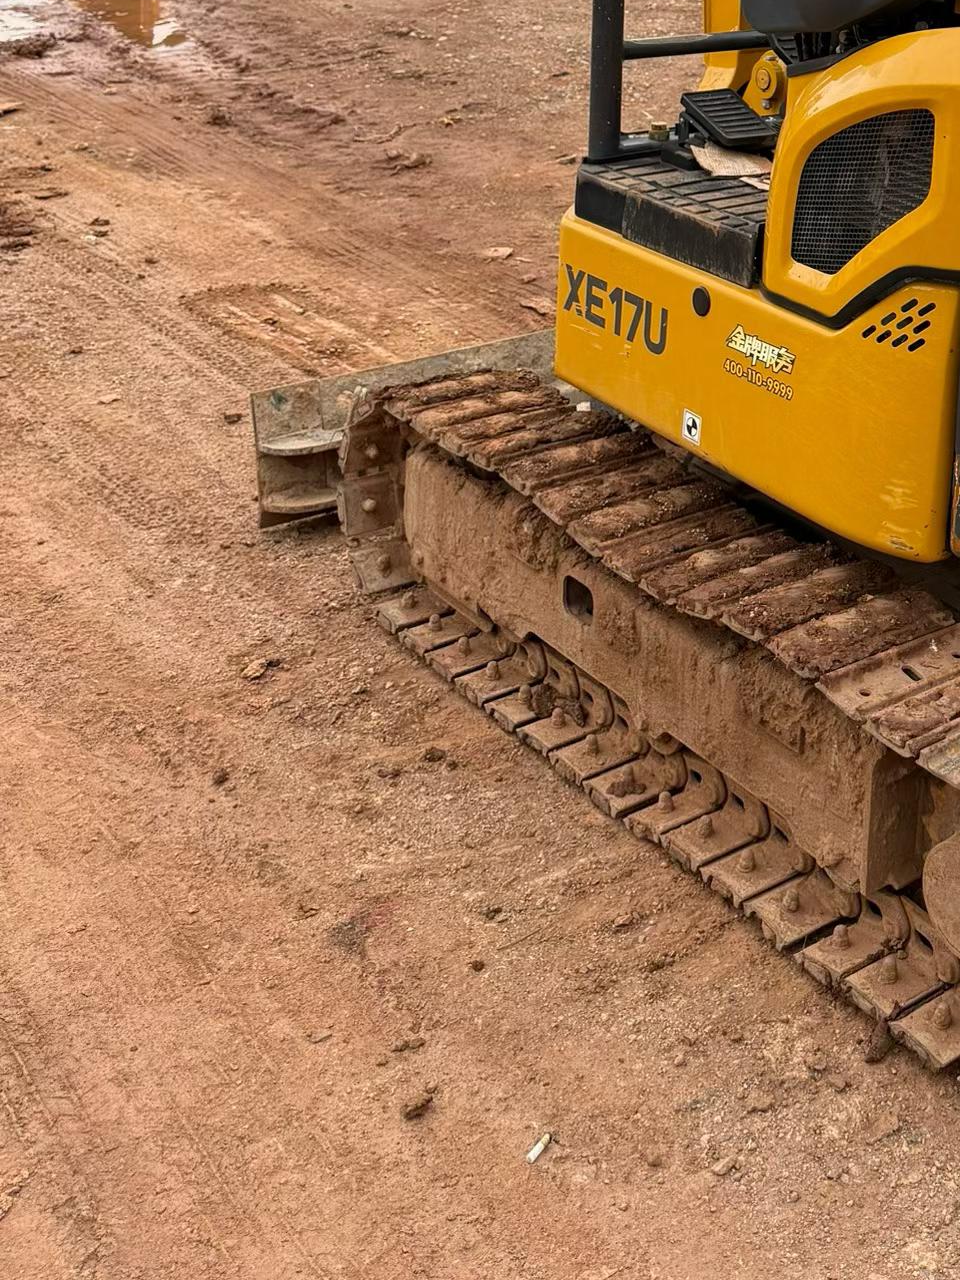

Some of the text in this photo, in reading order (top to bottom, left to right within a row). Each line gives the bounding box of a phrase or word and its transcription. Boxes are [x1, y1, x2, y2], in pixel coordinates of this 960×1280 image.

[563, 263, 668, 355] XE17U
[726, 324, 797, 375] 金牌服务
[723, 358, 794, 401] 400-110-9999
